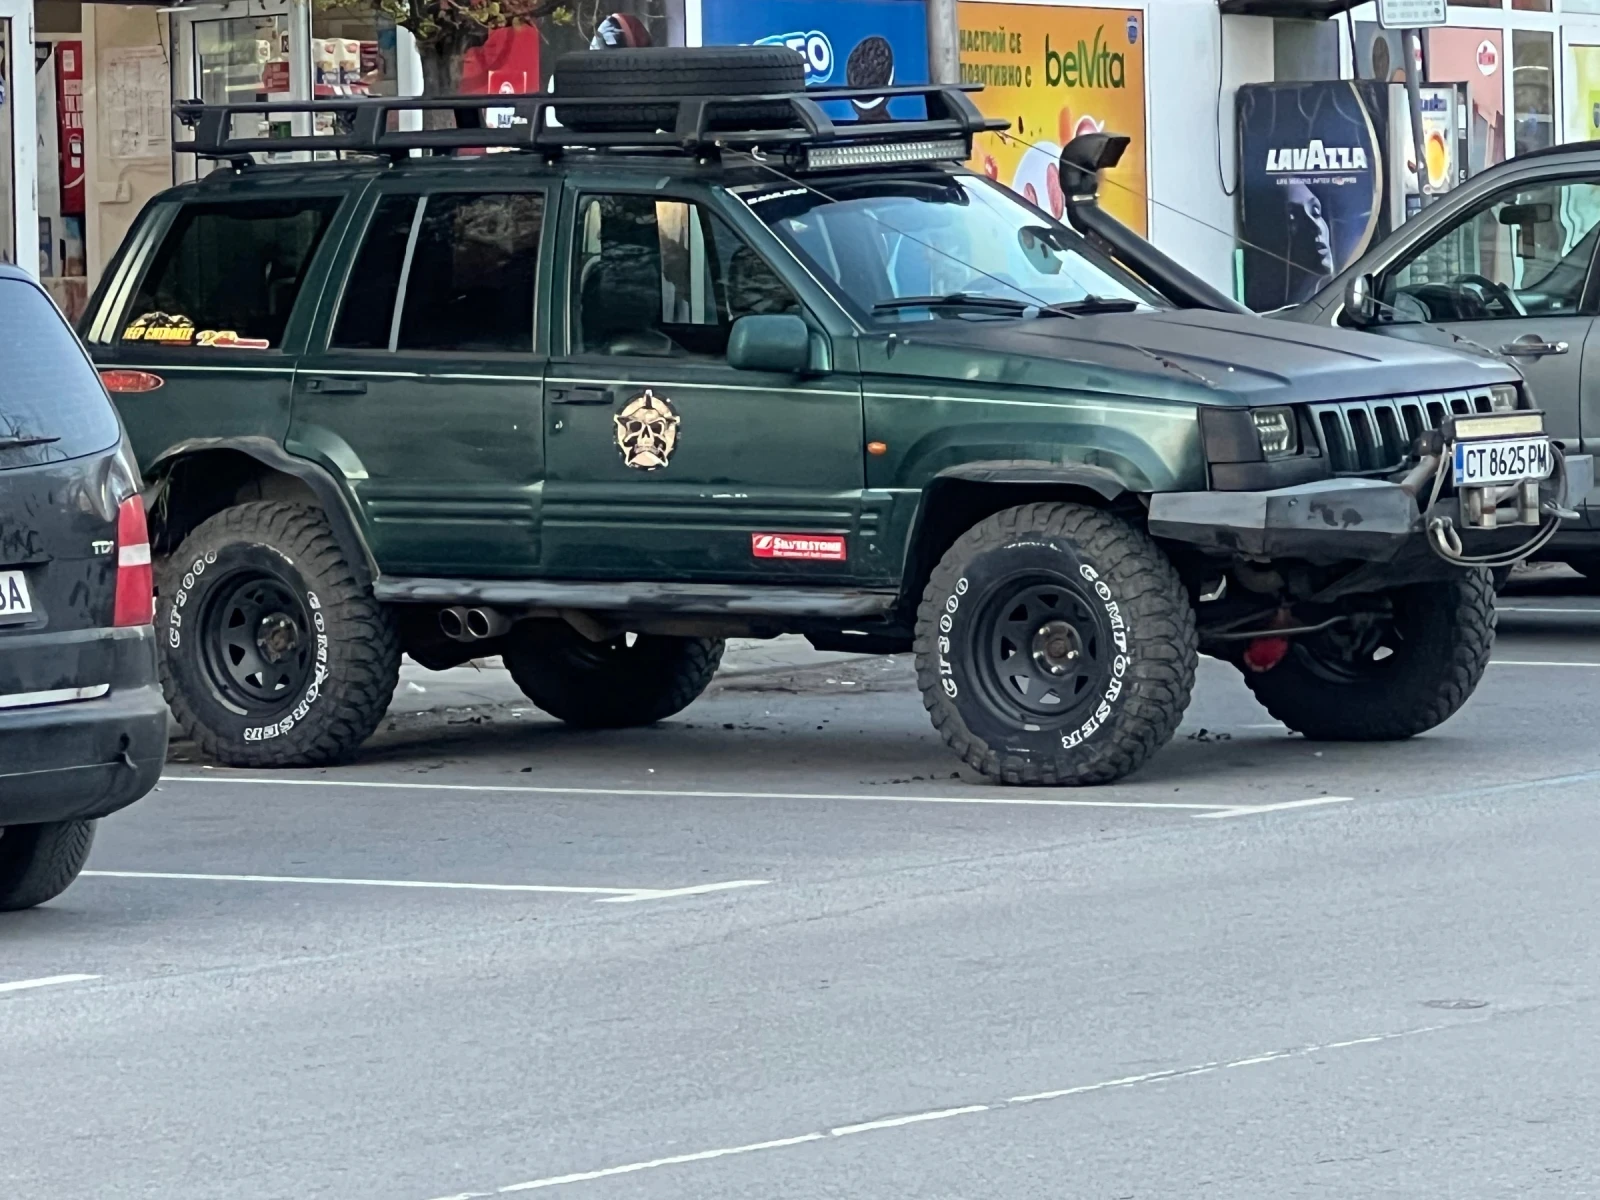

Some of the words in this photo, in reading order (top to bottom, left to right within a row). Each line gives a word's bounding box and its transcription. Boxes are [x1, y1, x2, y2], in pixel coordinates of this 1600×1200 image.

[959, 26, 1006, 54] НАСТРОЙ
[1009, 32, 1022, 54] СЕ
[1045, 24, 1125, 88] belVita
[959, 62, 1022, 88] ПОЗИТИВНО
[1266, 139, 1368, 171] LAVAZZA
[1466, 448, 1487, 478] CT
[1489, 445, 1526, 477] 8625
[1528, 443, 1547, 474] PM
[1061, 563, 1128, 749] COMFORSER
